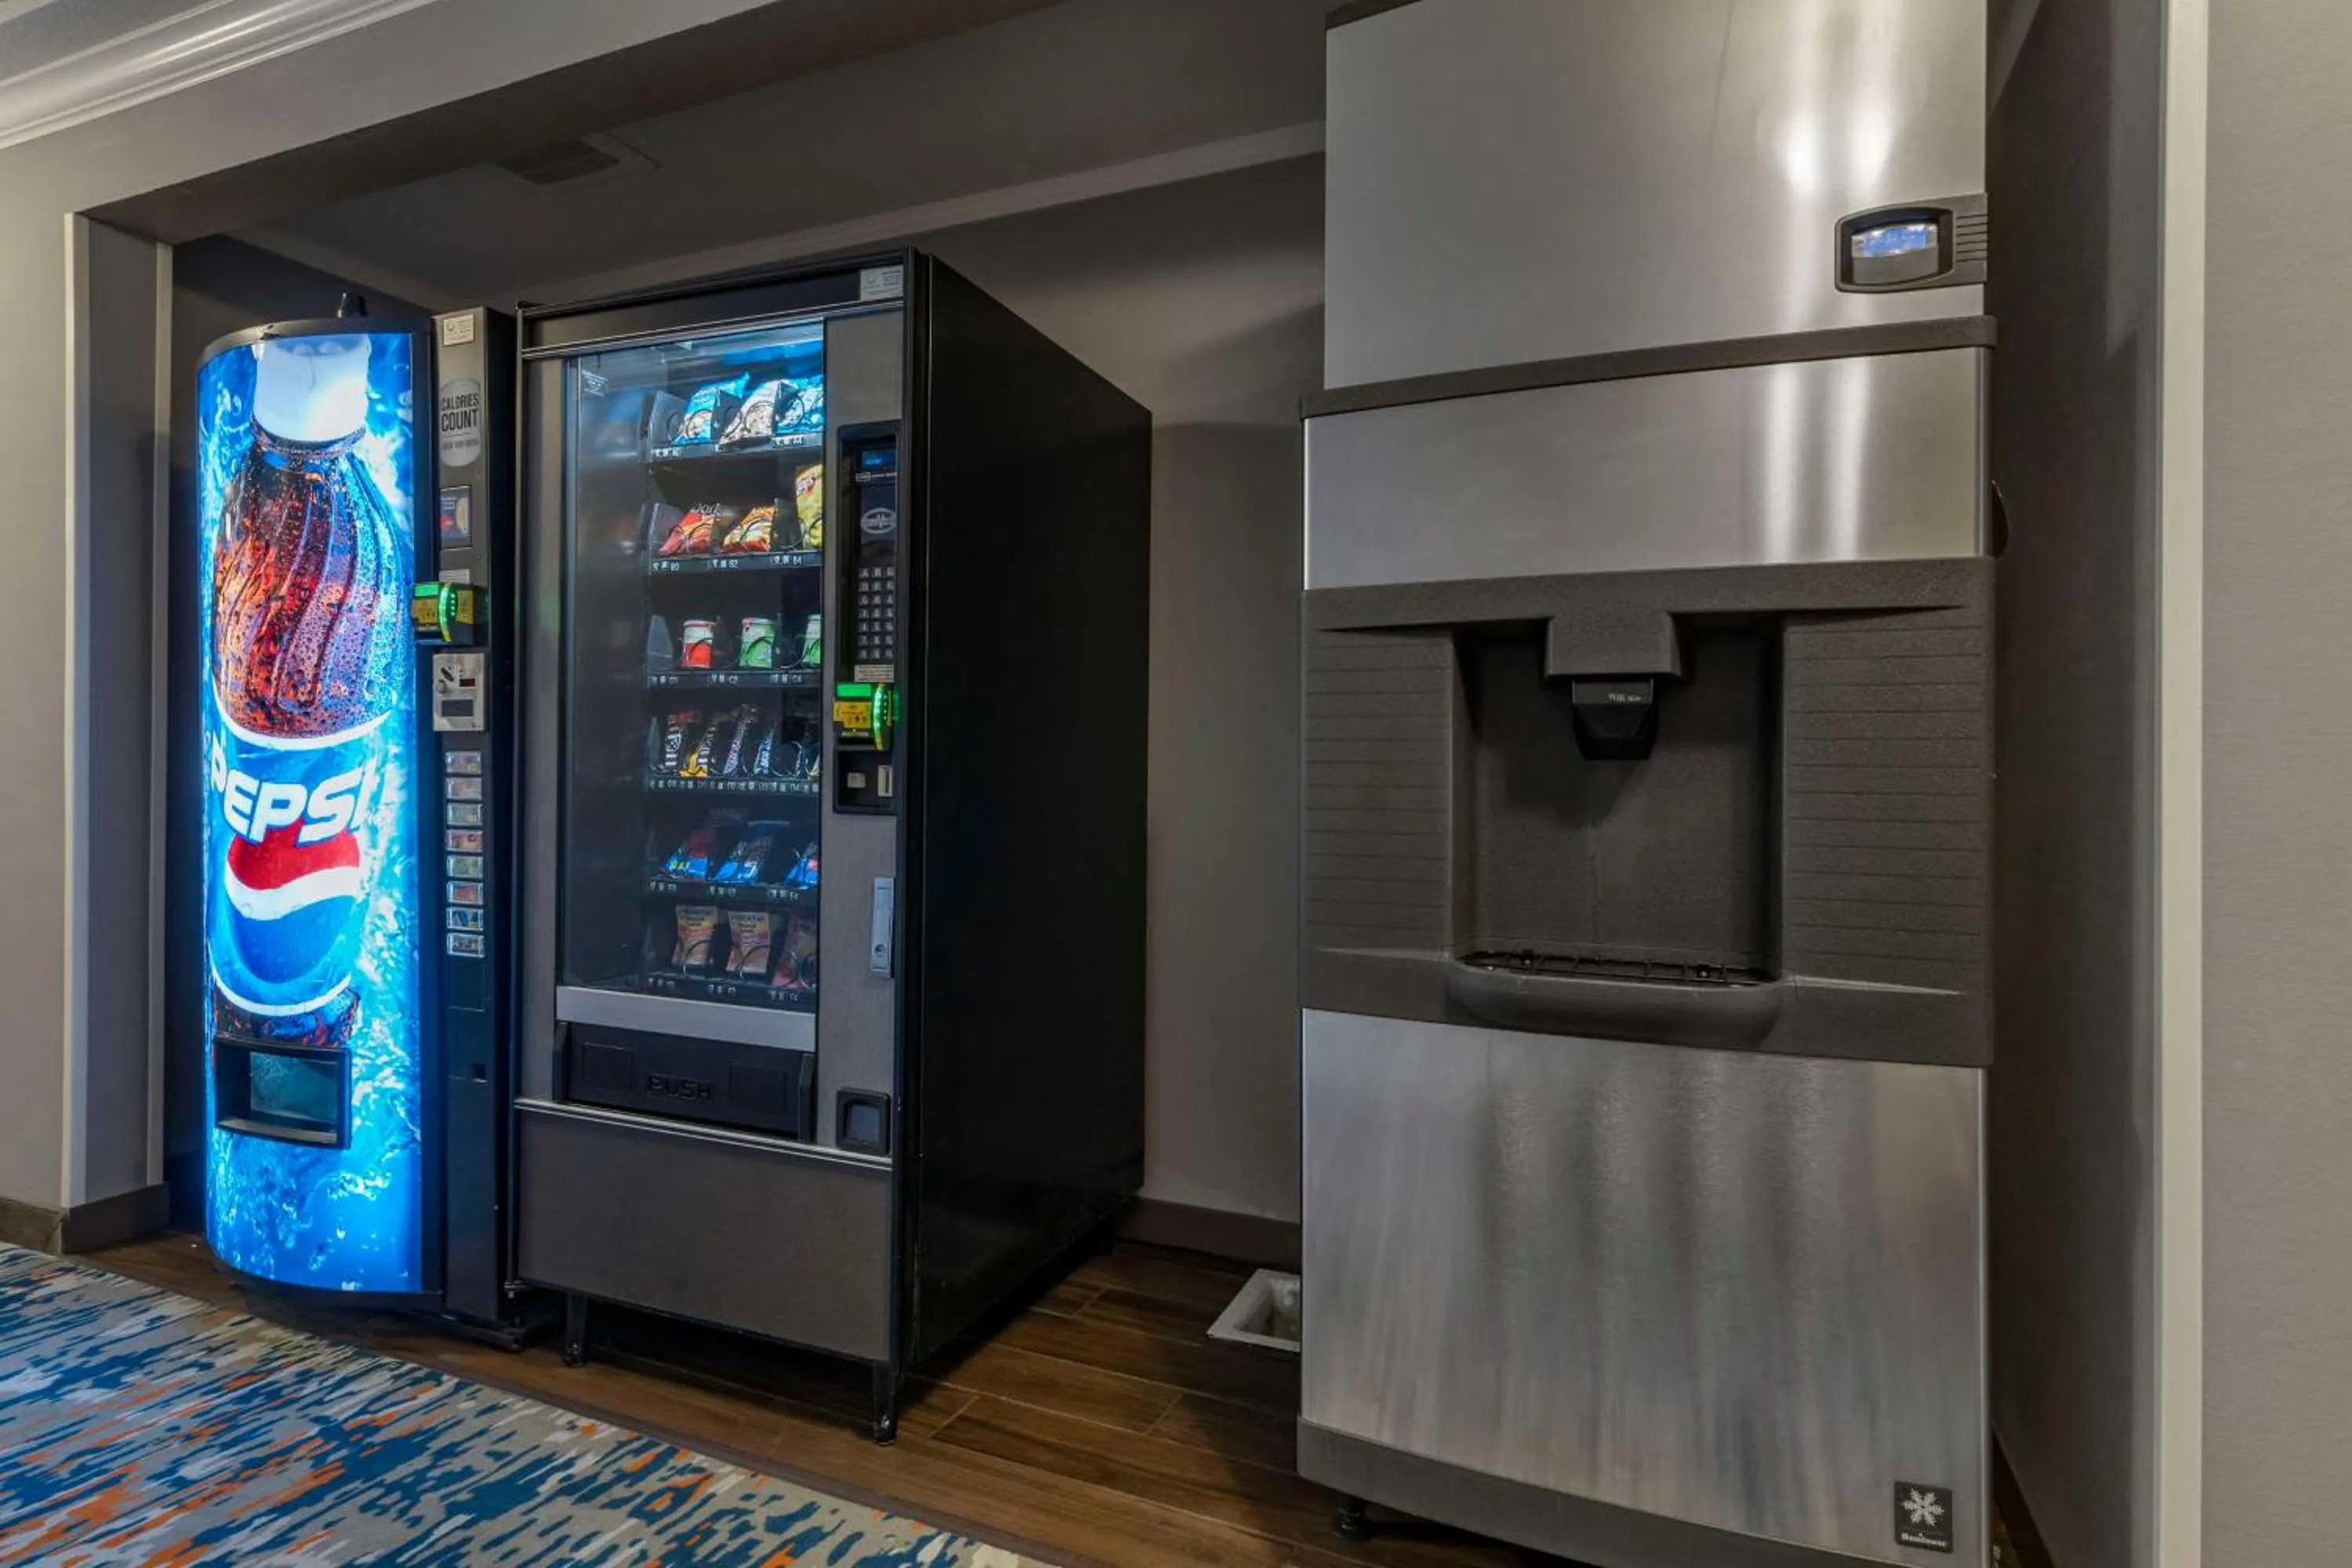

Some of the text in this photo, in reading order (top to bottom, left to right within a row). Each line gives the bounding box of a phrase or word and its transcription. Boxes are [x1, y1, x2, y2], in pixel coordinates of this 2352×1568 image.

[441, 393, 479, 411] CALORIES
[441, 409, 478, 431] COUNT
[211, 739, 379, 844] PEPSI
[648, 1075, 712, 1101] PUSH
